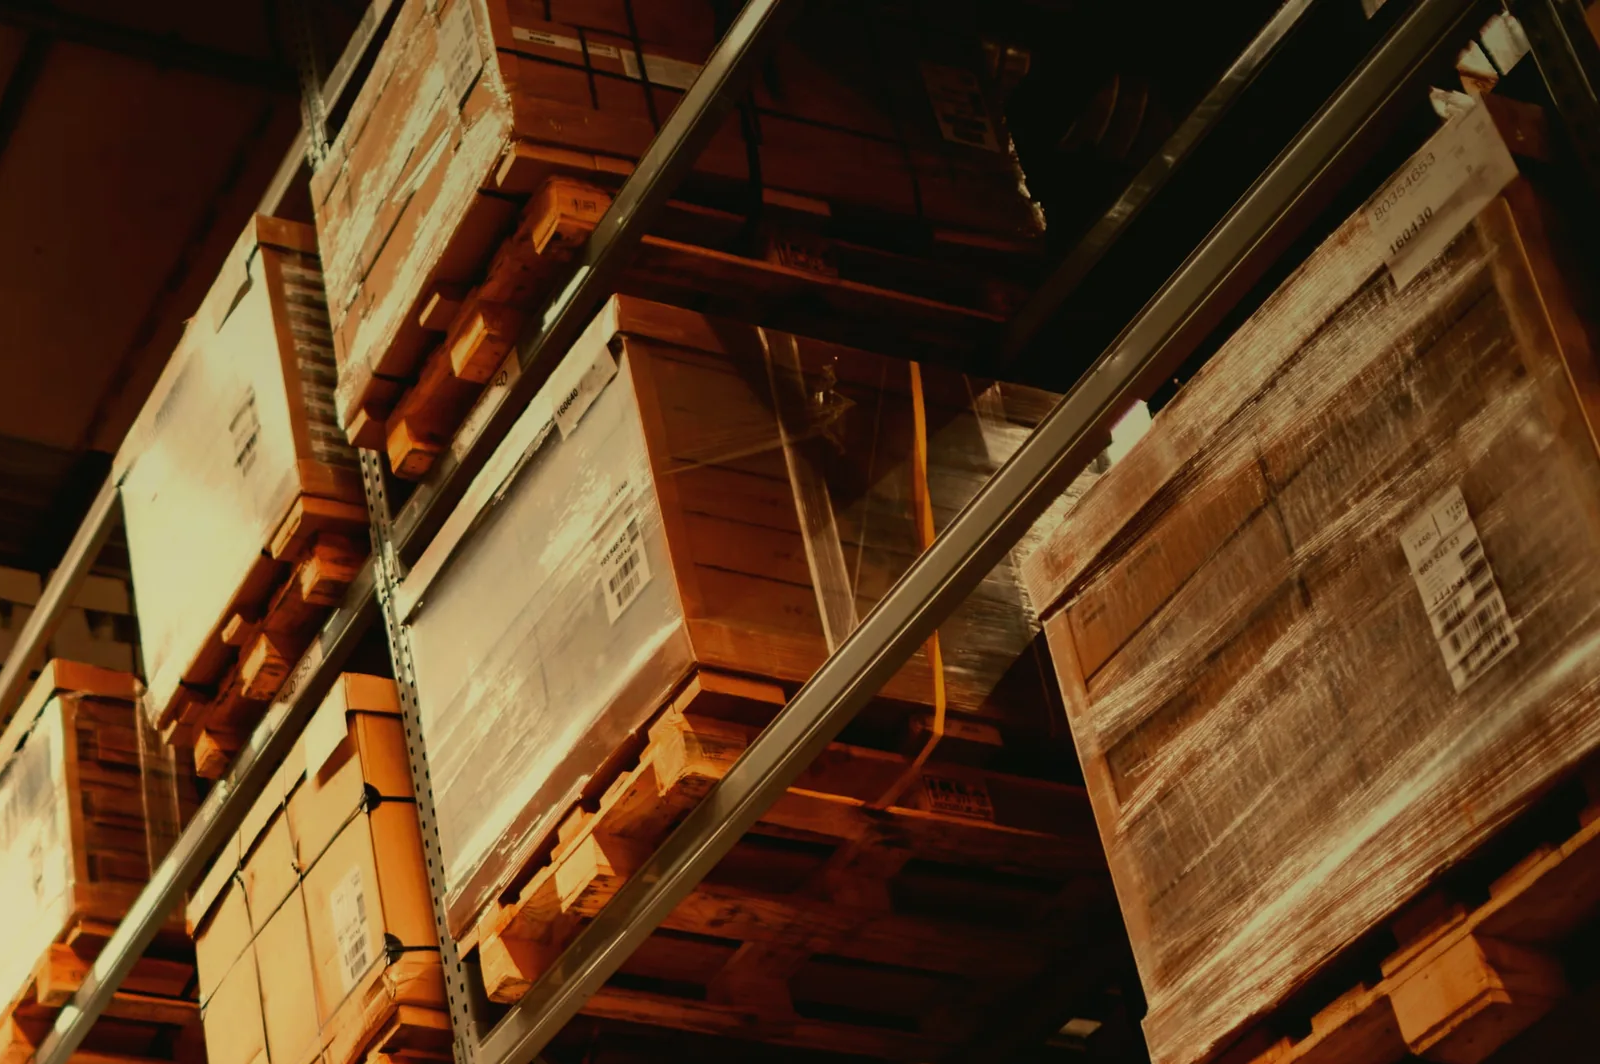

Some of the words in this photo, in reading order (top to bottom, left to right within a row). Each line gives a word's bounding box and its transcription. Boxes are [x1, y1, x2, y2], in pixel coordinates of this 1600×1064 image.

[1374, 152, 1436, 221] 80354653
[1388, 207, 1434, 255] 160430
[557, 388, 578, 417] 160640
